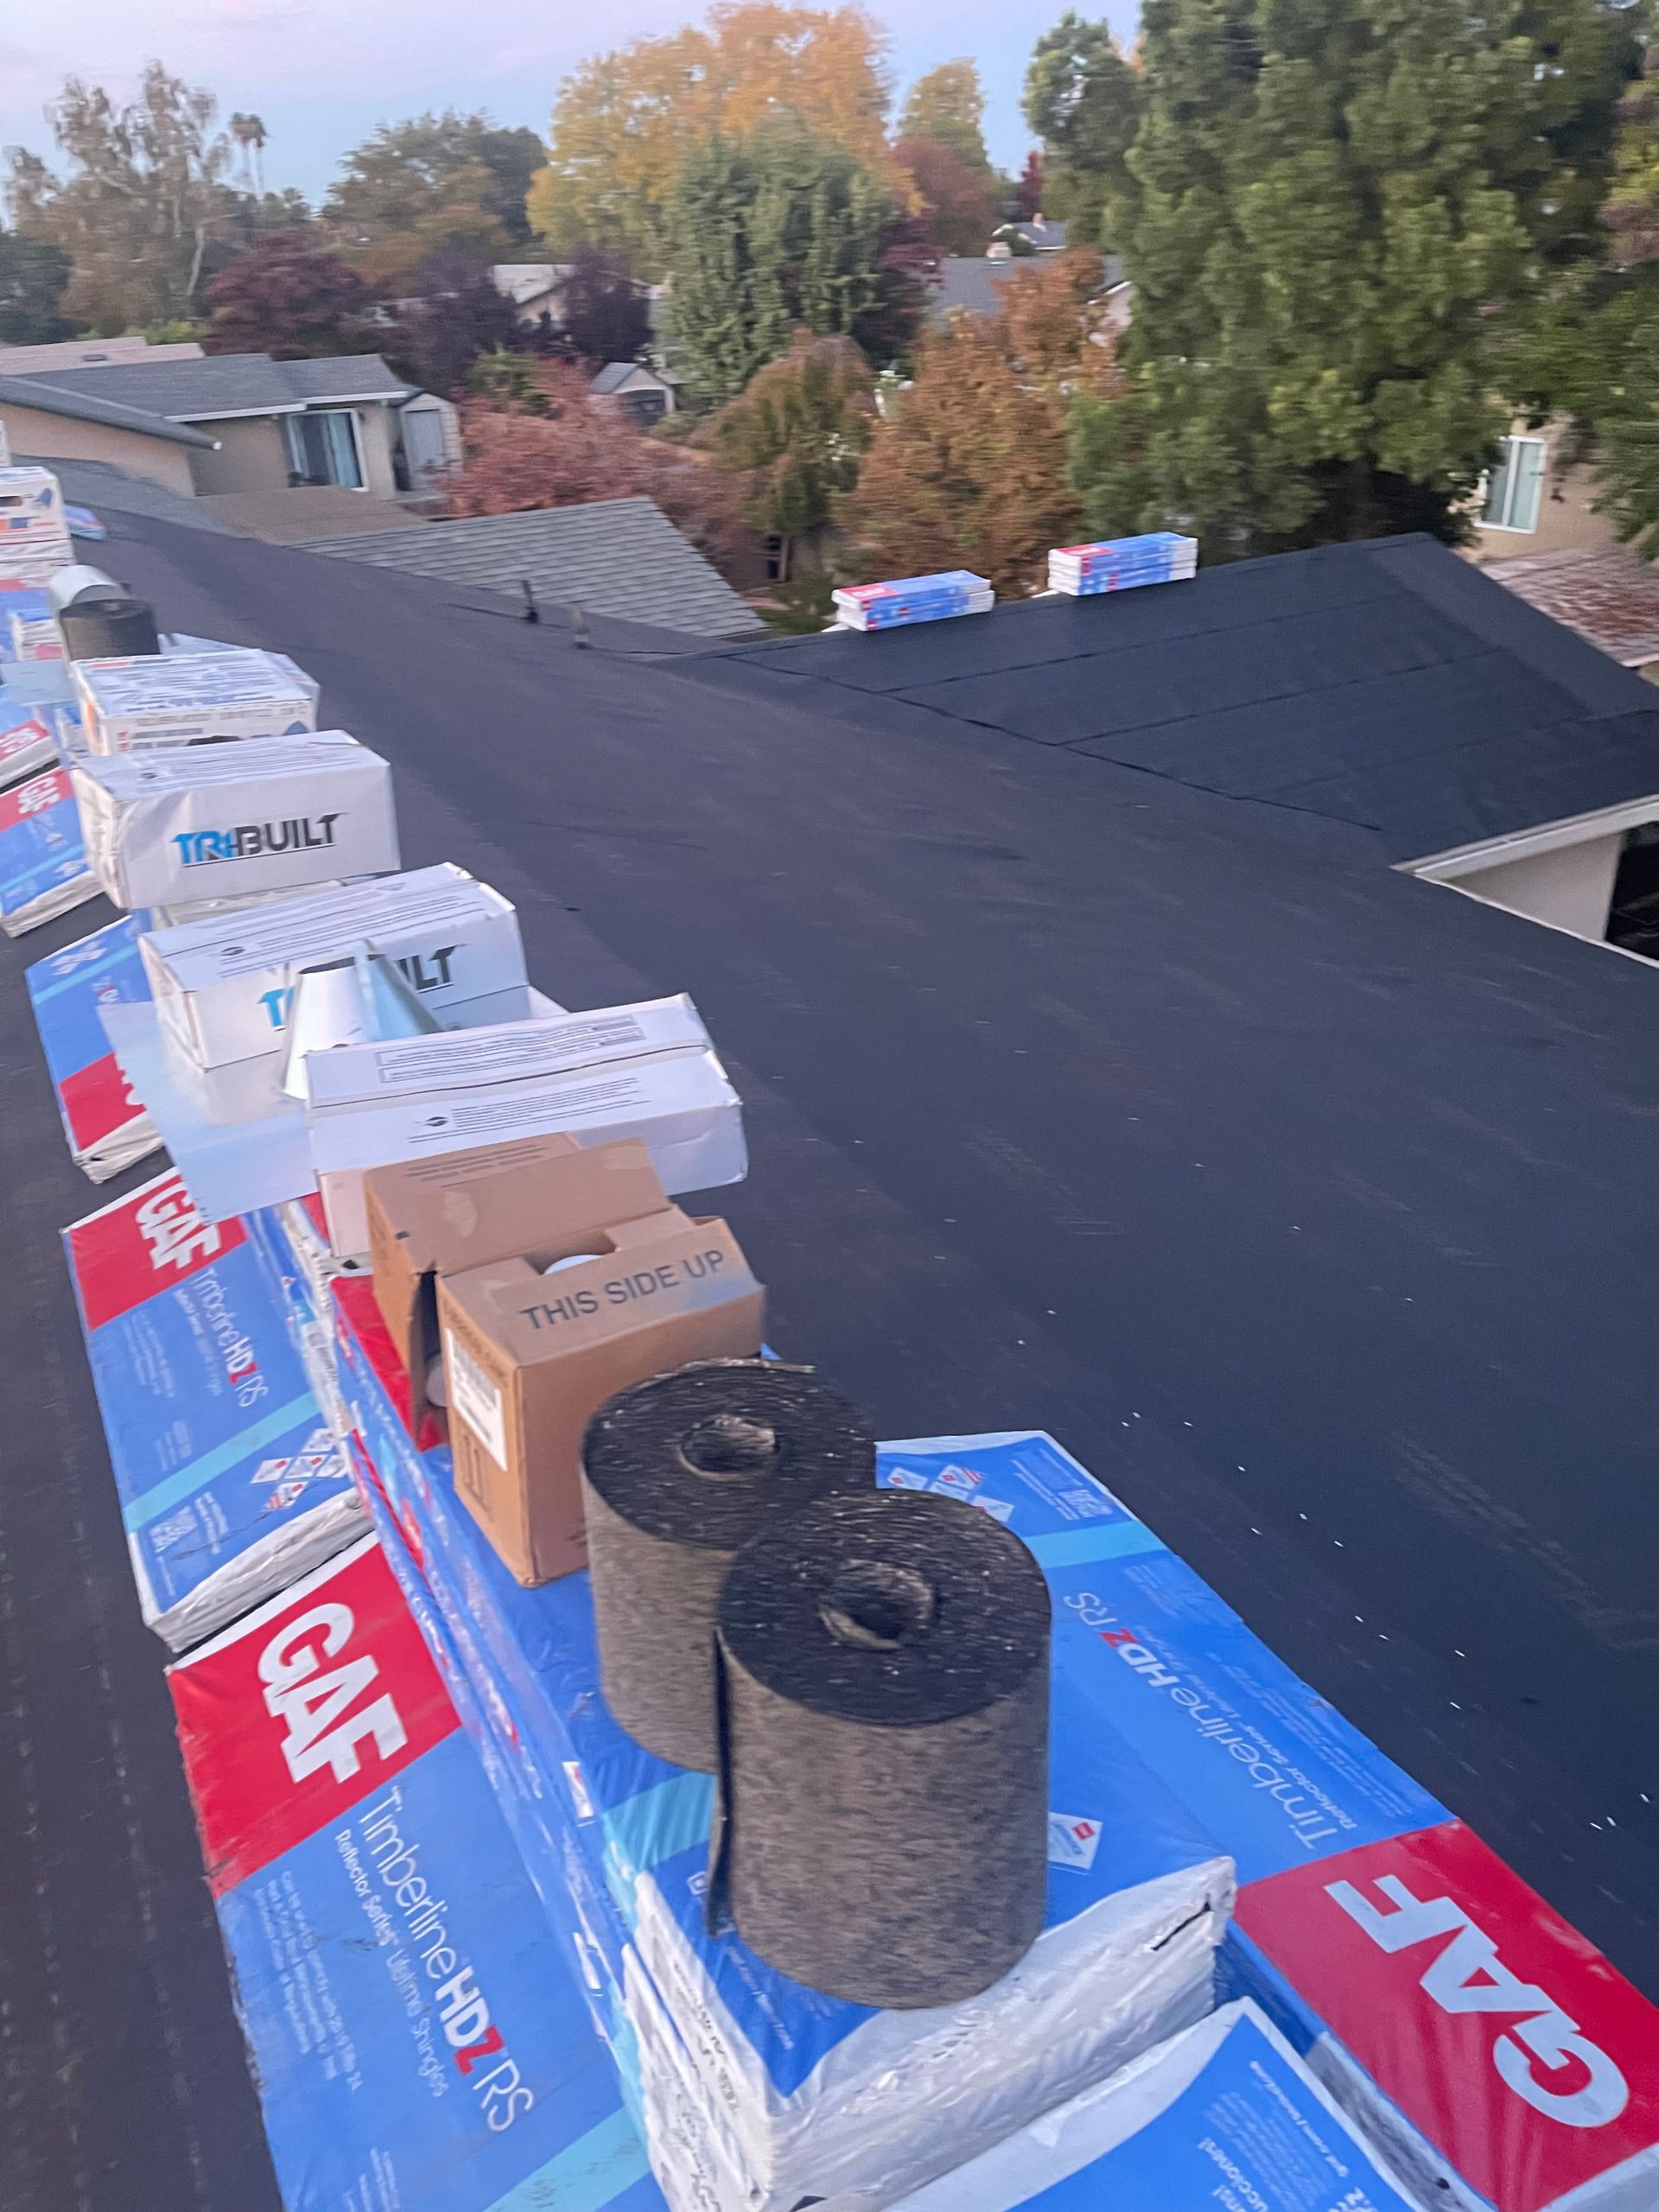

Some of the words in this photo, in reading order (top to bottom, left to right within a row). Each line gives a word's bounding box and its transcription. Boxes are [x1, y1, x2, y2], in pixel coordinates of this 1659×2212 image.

[135, 1180, 222, 1270] GAF
[518, 1291, 599, 1330] THIS
[605, 1265, 681, 1305] SIDE
[682, 1249, 724, 1279] UP
[1062, 1592, 1118, 1626] RS
[257, 1602, 409, 1784] GAF
[335, 1828, 372, 1897] Reflector
[1323, 1873, 1629, 2128] GAF
[463, 2058, 534, 2133] RS
